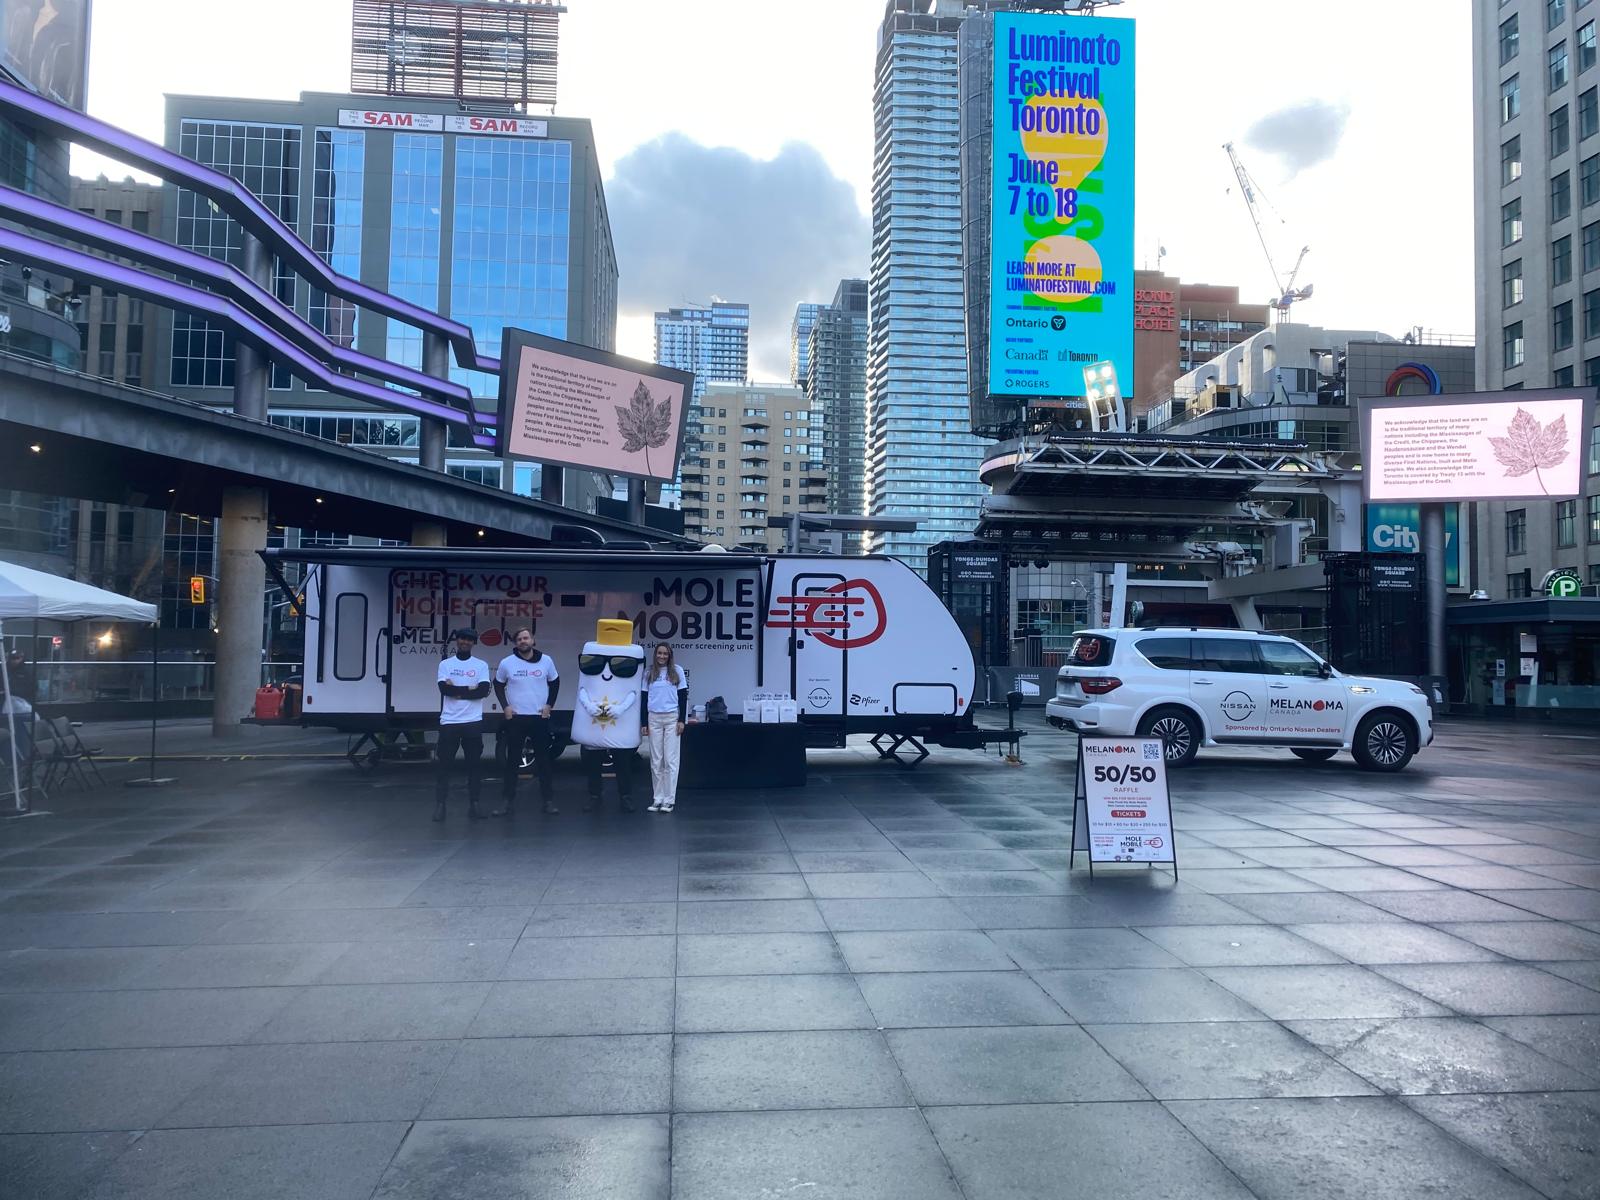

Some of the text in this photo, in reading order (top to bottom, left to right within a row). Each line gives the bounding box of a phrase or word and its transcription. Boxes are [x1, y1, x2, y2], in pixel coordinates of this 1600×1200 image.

[1008, 27, 1121, 66] Luminato
[1008, 62, 1100, 100] Festival
[364, 112, 413, 126] SAM
[1008, 98, 1100, 136] Toronto
[469, 118, 518, 132] SAM
[1007, 153, 1059, 185] June
[1008, 185, 1078, 218] 7 to 18
[1006, 261, 1076, 278] LEARN MORE AT
[1006, 278, 1116, 295] LUMINATOFESTIVAL.COM
[1135, 290, 1176, 301] BOND
[1135, 304, 1175, 317] PLACE
[1006, 318, 1048, 328] Ontario
[1135, 319, 1174, 331] HOTEL
[1005, 348, 1048, 360] Canada
[1068, 350, 1098, 362] TORONTO
[1016, 380, 1050, 388] ROGERS
[1066, 400, 1086, 408] cities
[393, 572, 548, 593] CHECK YOUR
[1560, 580, 1576, 596] P
[654, 577, 754, 608] MOLE
[395, 595, 544, 618] MOLES HERE
[617, 610, 754, 640] MOBILE
[695, 643, 735, 652] screening
[862, 698, 880, 708] Pfizer
[1270, 699, 1344, 711] MELANOMA
[1225, 724, 1260, 732] Sponsored
[1086, 746, 1136, 754] MELANOMA
[1094, 764, 1156, 785] 50/50
